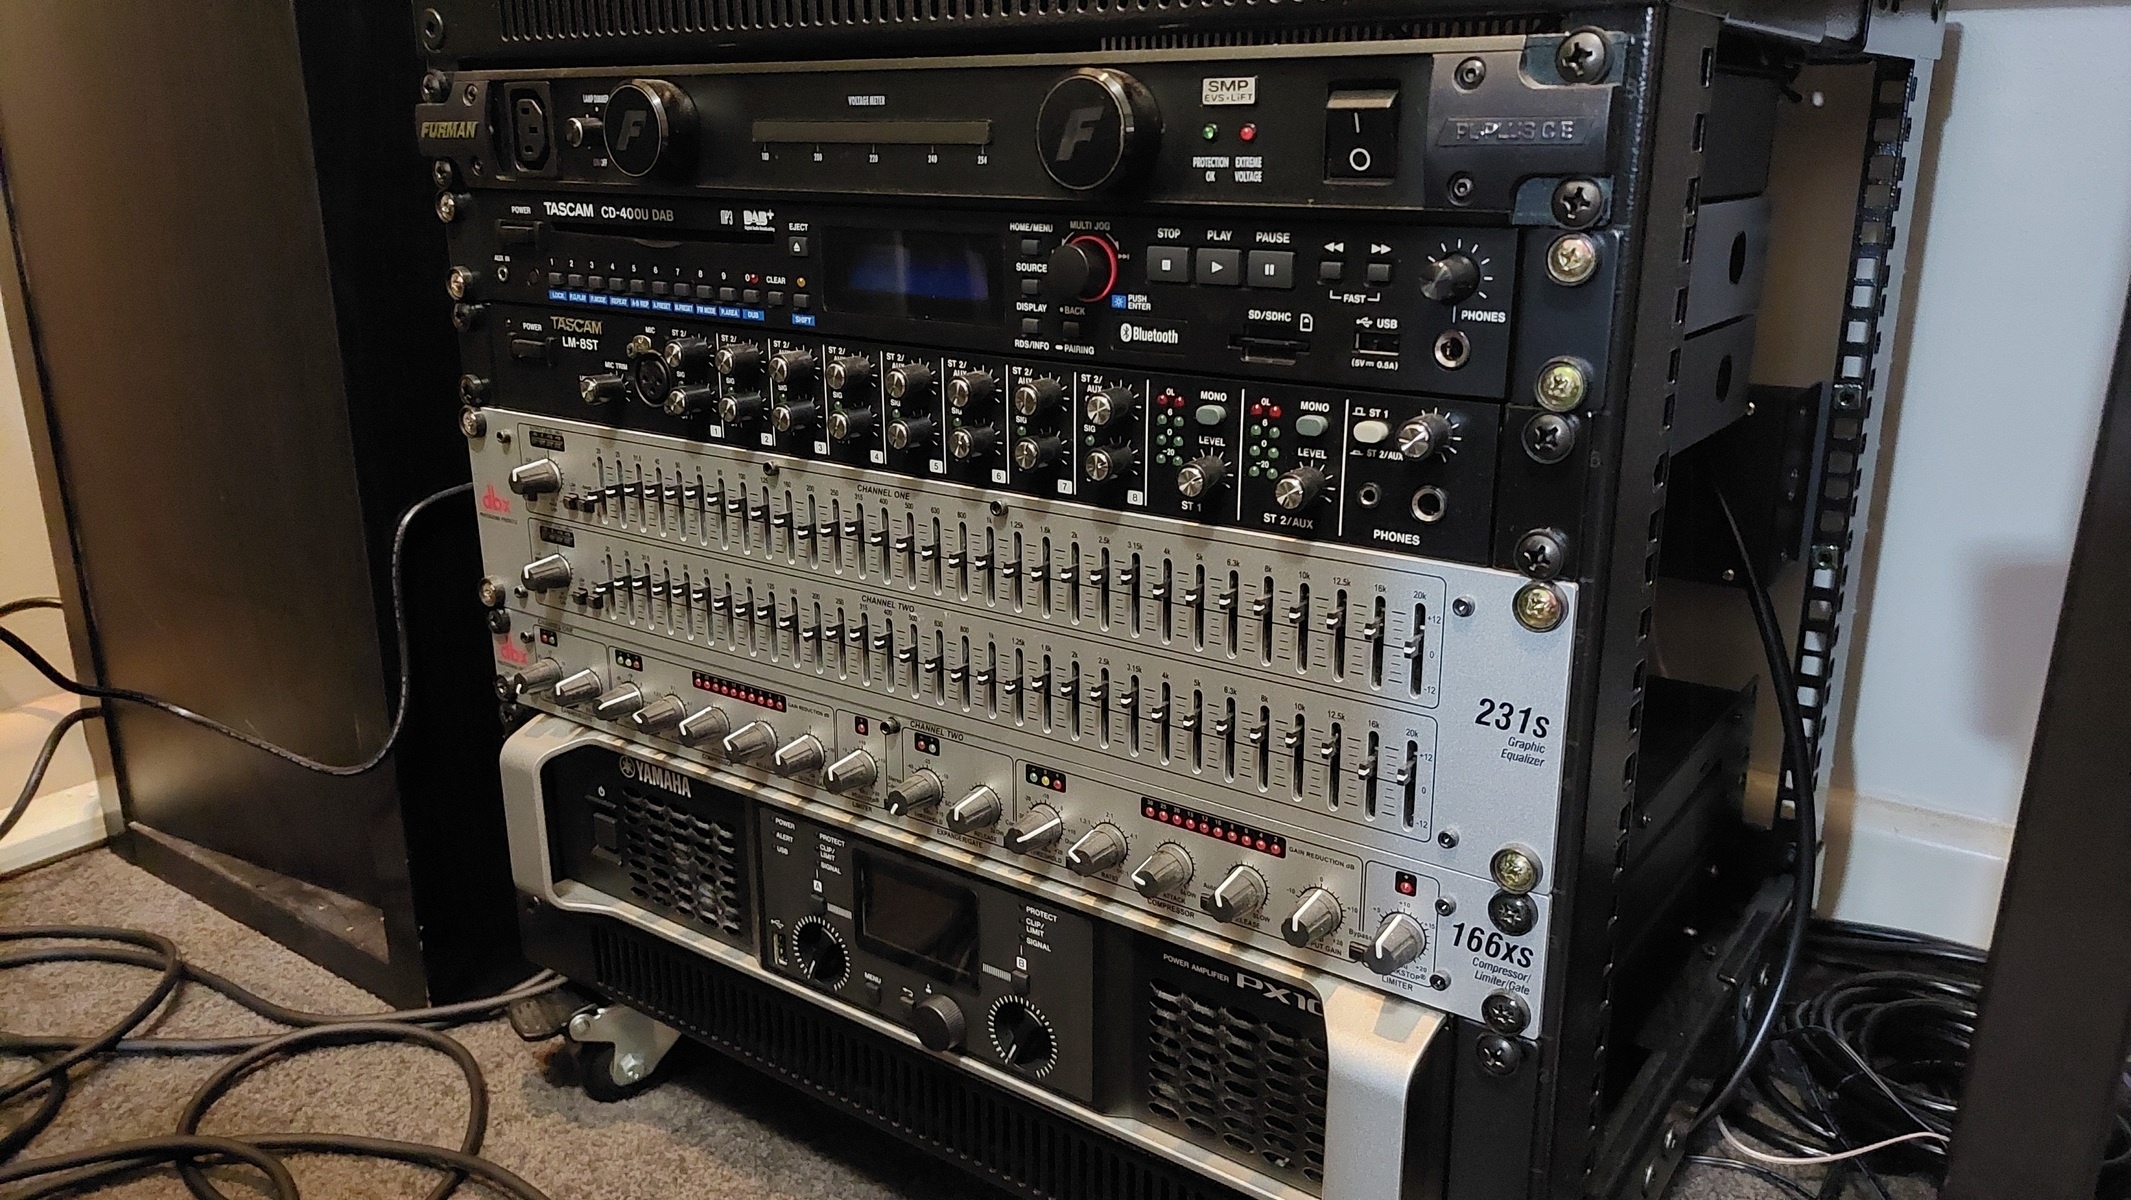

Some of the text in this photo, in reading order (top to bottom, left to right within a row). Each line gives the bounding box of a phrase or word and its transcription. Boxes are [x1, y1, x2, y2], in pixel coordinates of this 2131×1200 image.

[1208, 80, 1249, 92] SMP
[848, 95, 869, 105] VOLTAGE
[420, 121, 478, 138] FURMAN
[616, 110, 647, 151] F
[1055, 105, 1104, 161] F
[1193, 157, 1229, 168] PROTECTION
[1235, 157, 1262, 168] EXTREME
[1205, 171, 1216, 183] OK
[1234, 171, 1262, 183] VOLTAGE
[511, 206, 531, 215] POWER
[543, 202, 674, 221] TASCAM CD-400U DAB
[789, 223, 808, 231] EJECT
[1010, 222, 1053, 233] HOME/MENU
[1069, 221, 1110, 231] MULTI JOG
[1157, 228, 1180, 239] STOP
[1207, 230, 1233, 241] PLAY
[1256, 232, 1291, 243] PAUSE
[590, 261, 595, 269] 3
[631, 264, 636, 272] 5
[653, 266, 658, 274] 6
[1016, 262, 1047, 273] SOURCE
[675, 268, 680, 276] 7
[698, 270, 703, 278] 8
[721, 272, 726, 280] 9
[744, 274, 750, 282] 0
[766, 276, 786, 285] CLEAR
[1343, 293, 1366, 303] FAST
[1016, 302, 1047, 313] DISPLAY
[1065, 306, 1085, 315] BACK
[1128, 302, 1151, 311] ENTER
[795, 316, 811, 325] SHIFT
[1248, 309, 1292, 322] SD/SDHC
[1461, 310, 1506, 323] PHONES
[522, 322, 542, 331] POWER
[550, 316, 602, 334] TASCAM
[1376, 319, 1398, 329] USB
[645, 326, 656, 334] MIC
[1133, 326, 1178, 344] Bluetooth
[562, 336, 599, 351] LM-8ST
[1014, 340, 1049, 350] RDS/INFO
[1064, 344, 1095, 355] PAIRING
[886, 352, 895, 361] ST
[605, 361, 628, 370] MIC TRIM
[947, 359, 957, 368] ST
[1012, 366, 1022, 376] ST
[1081, 374, 1091, 383] ST
[1087, 384, 1102, 393] AUX
[1200, 391, 1227, 401] MONO
[1300, 401, 1330, 412] MONO
[1369, 408, 1388, 418] ST 1
[1084, 424, 1096, 433] SIG
[1198, 436, 1226, 447] LEVEL
[1298, 447, 1327, 459] LEVEL
[1366, 449, 1403, 461] ST 2/AUX
[857, 484, 910, 500] CHANNEL ONE
[482, 485, 511, 513] dbx
[1181, 501, 1201, 512] ST 1
[1263, 513, 1314, 529] ST 2/AUX
[1373, 529, 1420, 546] PHONES
[1127, 541, 1143, 550] 3.15k
[1196, 553, 1203, 561] 5k
[1227, 558, 1240, 567] 6.3k
[1265, 565, 1272, 573] 8k
[1299, 571, 1310, 580] 10k
[1332, 577, 1351, 587] 12.5k
[1374, 584, 1386, 593] 16k
[1413, 591, 1426, 600] 20k
[861, 595, 915, 613] CHANNEL TWO
[1427, 615, 1441, 624] +12
[1423, 686, 1436, 694] -12
[1294, 702, 1305, 711] 10k
[1327, 710, 1345, 721] 12.5k
[1368, 719, 1380, 728] 16k
[910, 720, 963, 741] CHANNEL TWO
[1405, 728, 1418, 738] 20k
[1507, 736, 1546, 754] Graphic
[1419, 753, 1433, 762] +12
[1500, 748, 1546, 767] Equalizer
[636, 760, 692, 798] YAMAHA
[775, 816, 795, 831] POWER
[776, 831, 793, 844] ALERT
[819, 832, 846, 848] PROTECT
[936, 828, 983, 849] EXPANDER/GATE
[776, 845, 788, 856] USB
[819, 843, 835, 855] CLIP/
[820, 850, 836, 862] LIMIT
[1288, 847, 1355, 871] GAIN REDUCTION dB
[820, 861, 842, 875] SIGNAL
[1148, 898, 1195, 919] COMPRESSOR
[1398, 901, 1411, 909] +10
[1025, 905, 1057, 923] PROTECT
[1025, 918, 1045, 931] CLIP/
[1026, 925, 1045, 938] LIMIT
[1348, 928, 1372, 941] Bypass
[1026, 937, 1052, 953] SIGNAL
[1163, 953, 1189, 969] POWER
[1191, 963, 1230, 984] AMPLIFIER
[1472, 956, 1532, 984] Compressor/
[864, 971, 882, 985] MENU
[1381, 974, 1414, 992] LIMITER
[1474, 969, 1531, 995] Limiter/Gate
